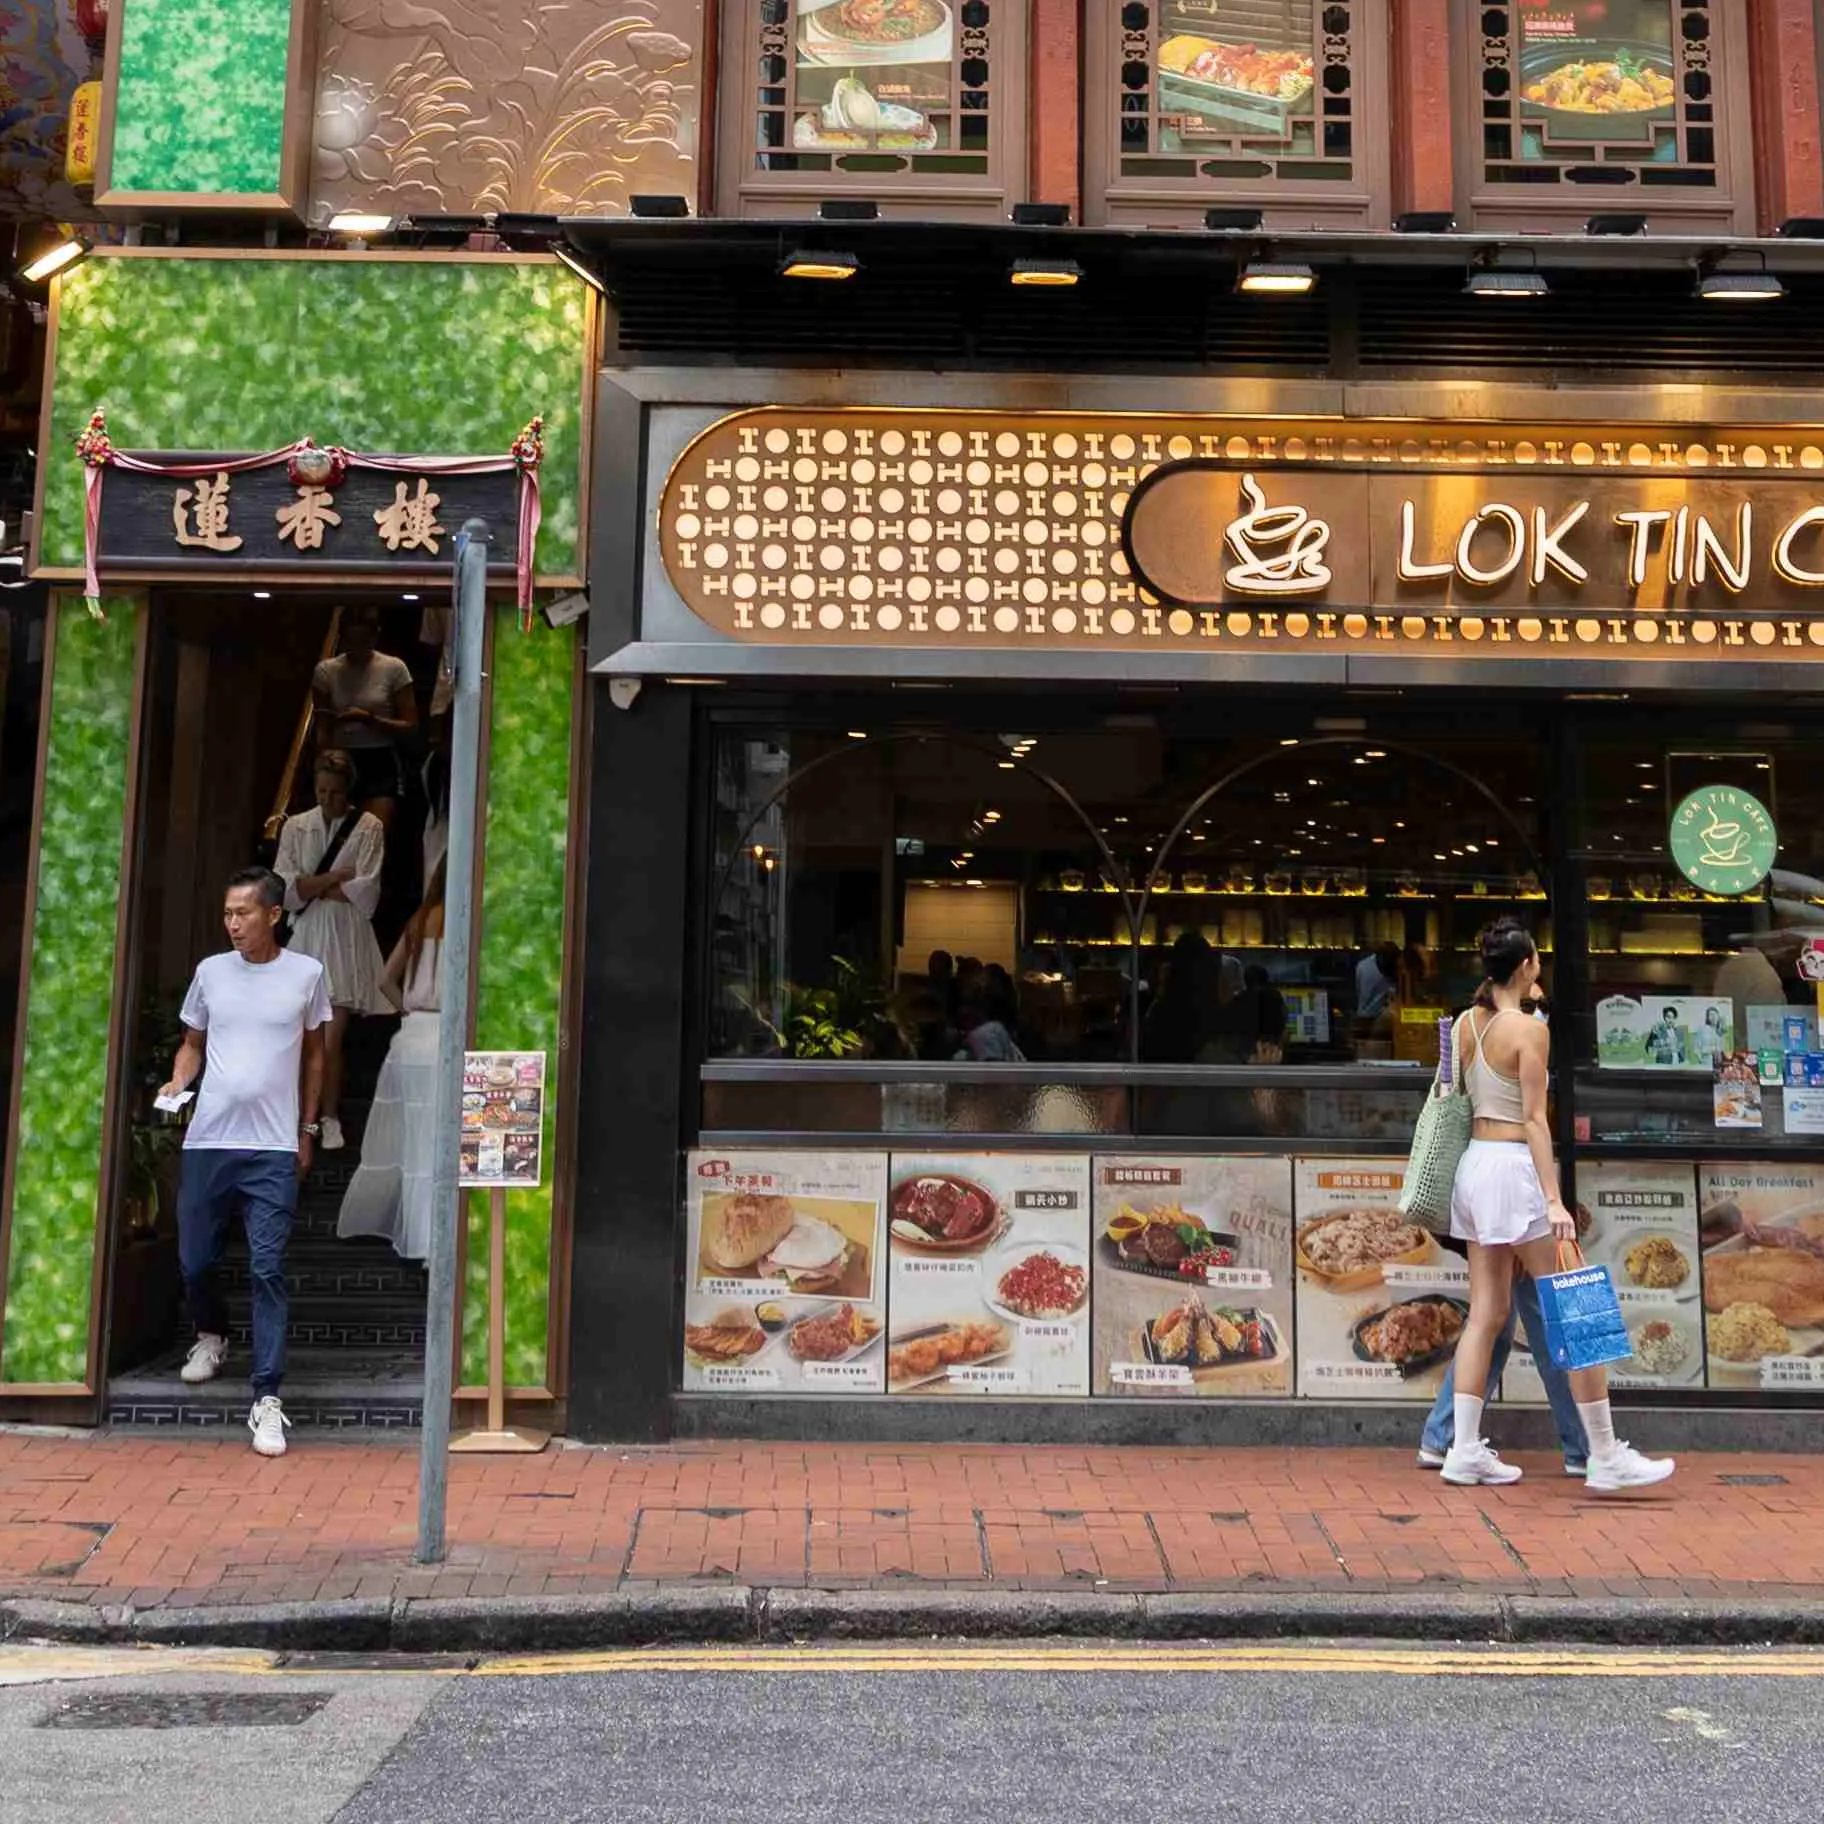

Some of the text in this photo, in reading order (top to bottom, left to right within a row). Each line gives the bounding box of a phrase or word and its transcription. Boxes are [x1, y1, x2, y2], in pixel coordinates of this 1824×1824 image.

[174, 473, 445, 555] 蓮香樓
[1399, 499, 1590, 584] LOK
[1614, 502, 1753, 591] TIN
[1679, 801, 1701, 825] LOK
[1709, 792, 1735, 805] TIN
[1552, 1272, 1606, 1289] bakehouse
